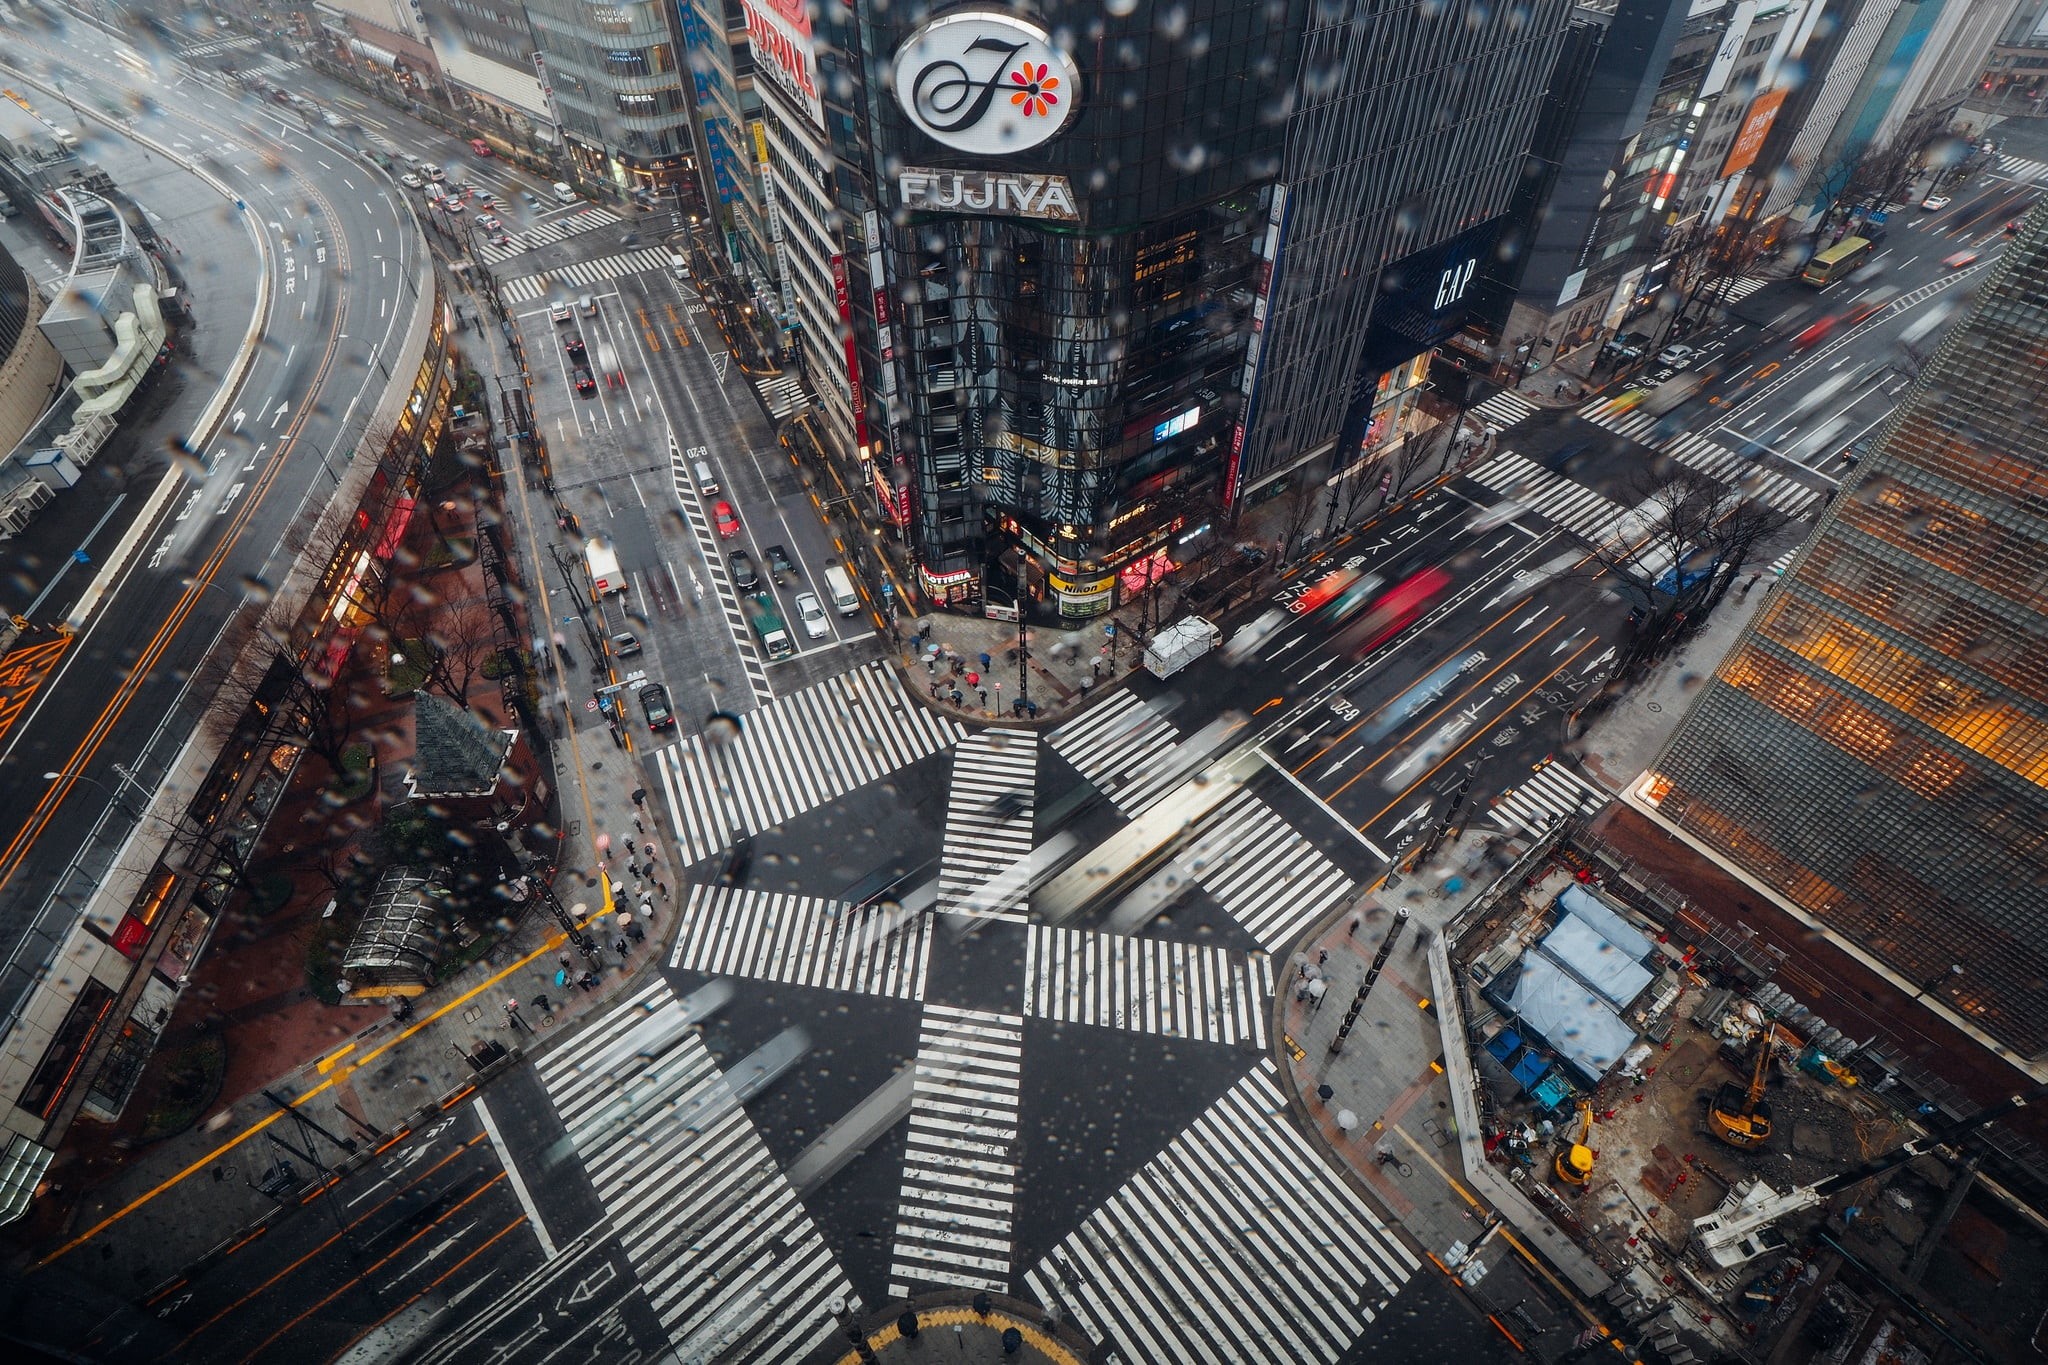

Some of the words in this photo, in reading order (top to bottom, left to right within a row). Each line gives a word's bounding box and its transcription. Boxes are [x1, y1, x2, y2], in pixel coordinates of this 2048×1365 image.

[620, 94, 655, 102] DIESEL
[900, 171, 1078, 216] FUJIYA
[1434, 258, 1477, 310] GAP
[686, 446, 707, 459] 8-20
[924, 571, 972, 584] LOTTERIA
[1064, 584, 1098, 593] Nikon
[1271, 590, 1307, 614] 17-19
[1330, 698, 1361, 722] 8-20
[1727, 1131, 1750, 1144] CAT
